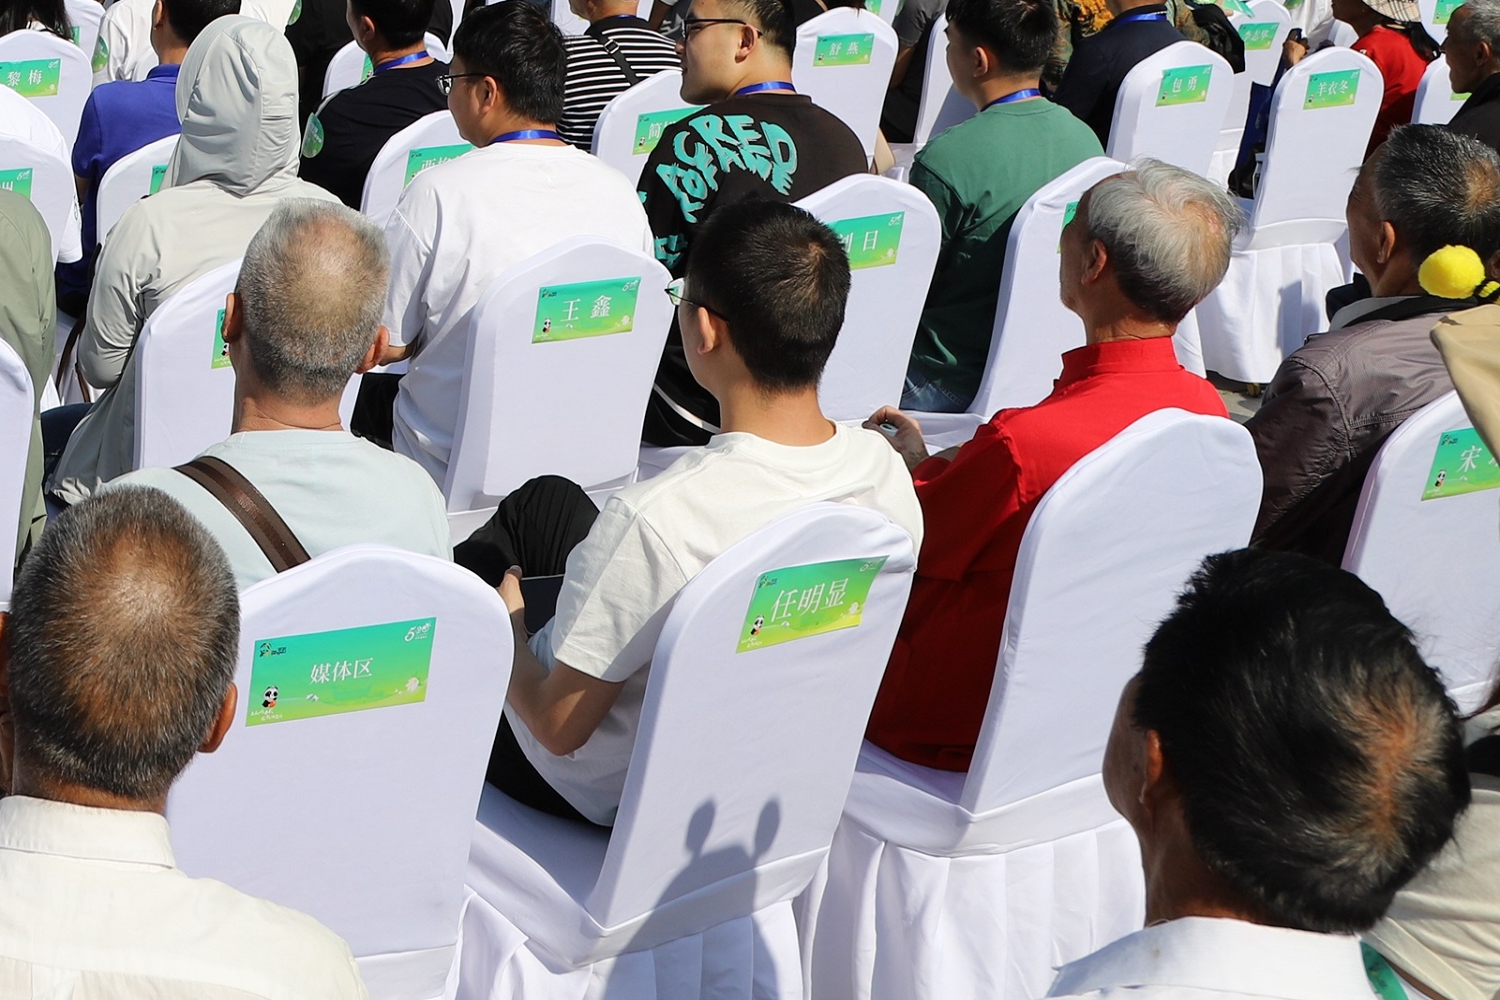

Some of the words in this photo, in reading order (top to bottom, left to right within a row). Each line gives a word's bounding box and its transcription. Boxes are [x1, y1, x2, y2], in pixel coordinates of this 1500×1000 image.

[1172, 75, 1198, 94] 包勇
[561, 294, 612, 323] 王鑫
[771, 577, 850, 623] 任明显
[309, 657, 374, 685] 媒体区
